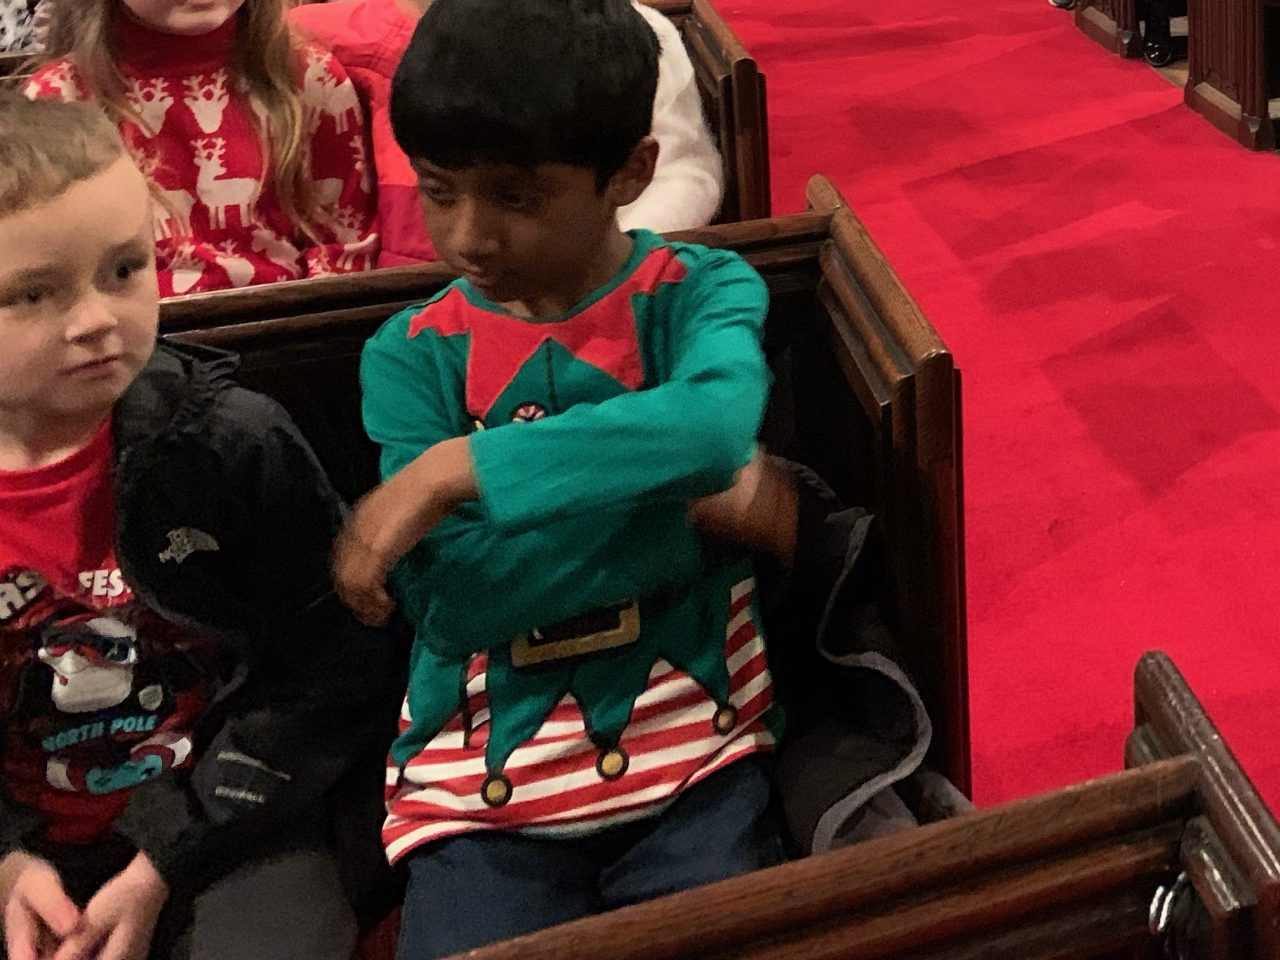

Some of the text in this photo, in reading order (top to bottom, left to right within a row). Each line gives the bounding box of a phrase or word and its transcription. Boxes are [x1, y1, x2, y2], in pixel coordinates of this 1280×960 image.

[78, 568, 131, 598] FES
[41, 714, 157, 751] NORTH POLE
